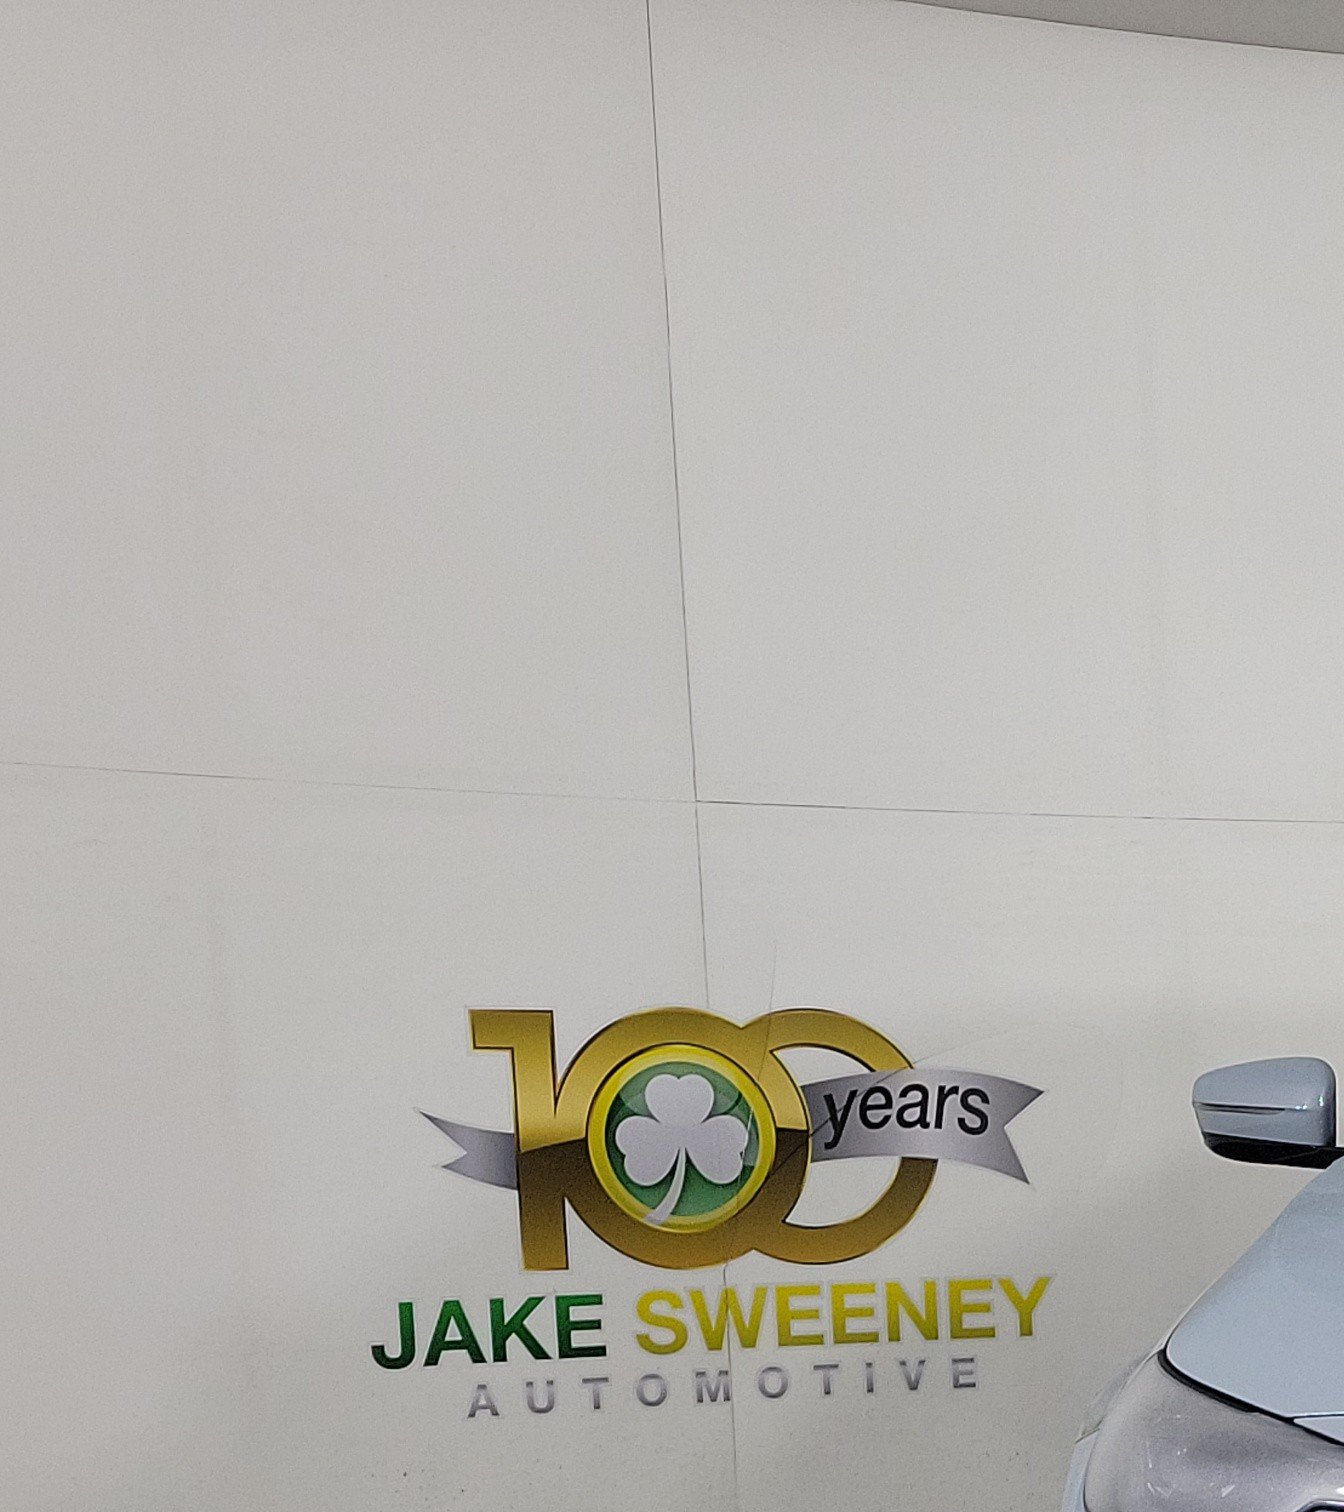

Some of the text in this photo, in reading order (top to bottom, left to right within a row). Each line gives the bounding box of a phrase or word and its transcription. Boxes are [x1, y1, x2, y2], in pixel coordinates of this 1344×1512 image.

[824, 1082, 991, 1150] years
[370, 1276, 1054, 1370] JAKE SWEENEY
[467, 1357, 978, 1419] AUTOMOTIVE
